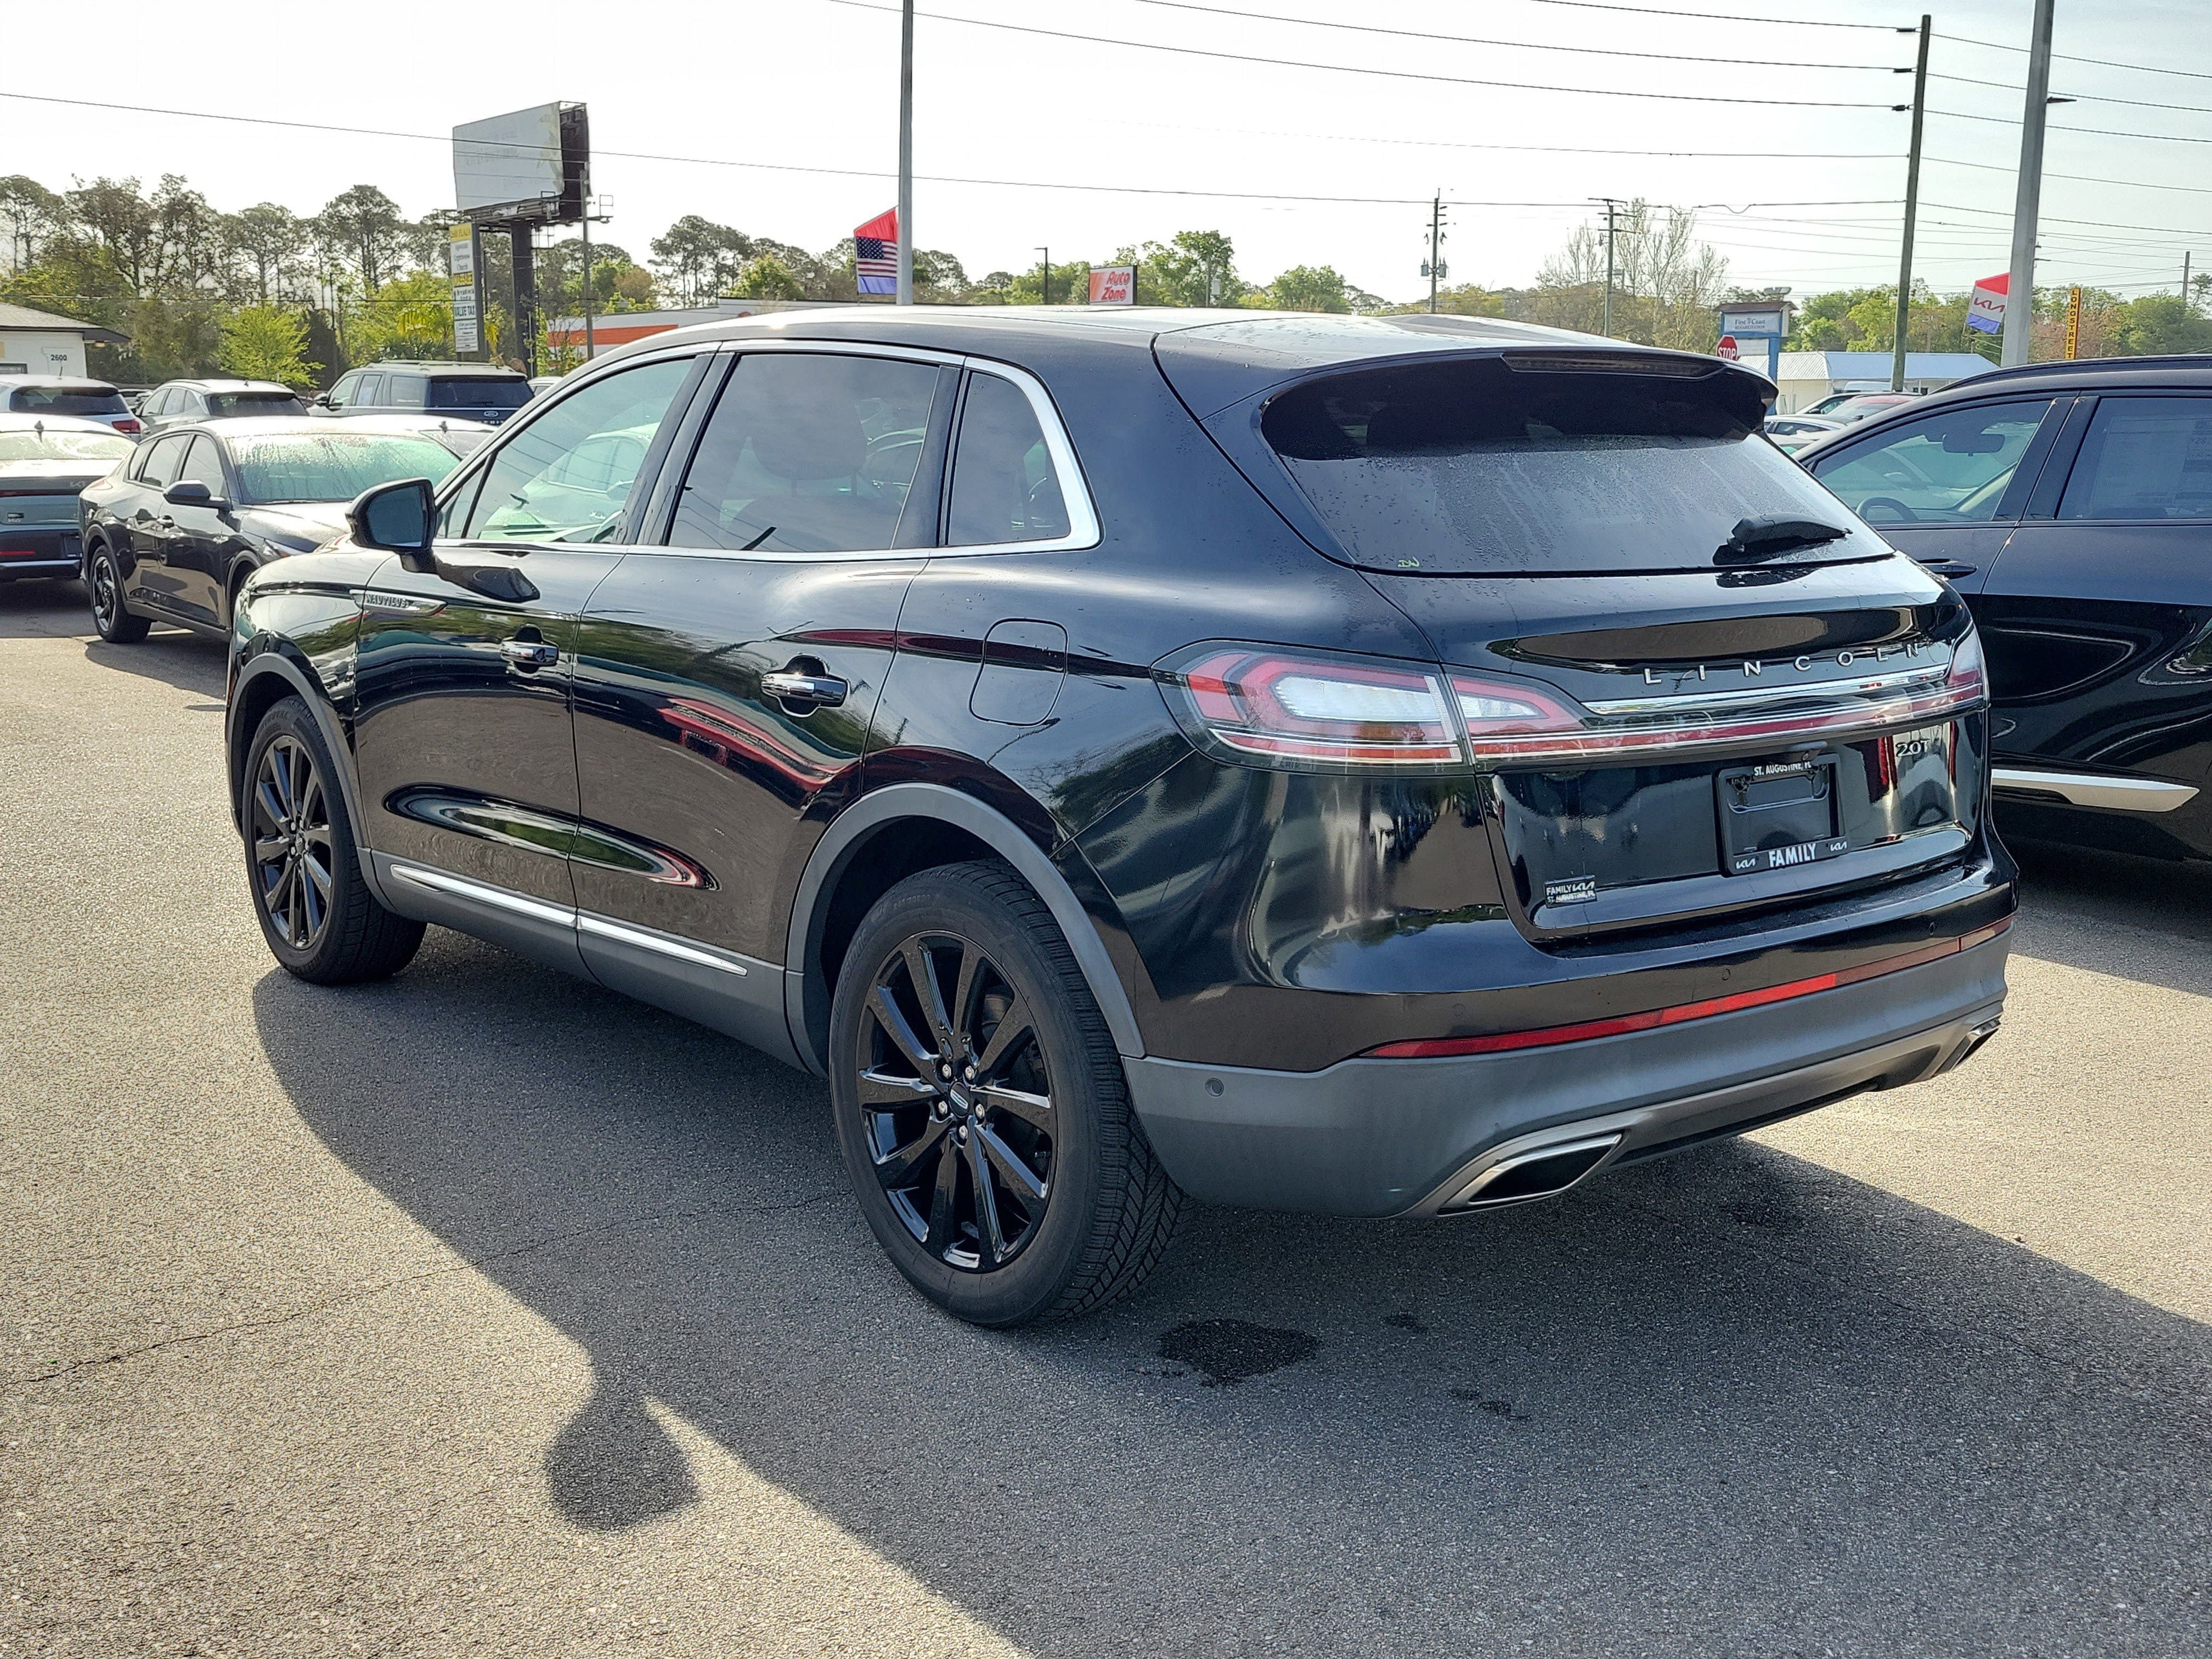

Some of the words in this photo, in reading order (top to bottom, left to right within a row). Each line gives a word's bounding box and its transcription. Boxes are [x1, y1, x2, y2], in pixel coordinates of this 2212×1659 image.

[1106, 271, 1130, 285] Auto
[1101, 287, 1126, 302] Zone
[2067, 290, 2078, 358] LONGSTREET
[1718, 347, 1737, 361] STOP
[1644, 644, 1919, 685] LINCOLN
[1754, 766, 1764, 776] ST.
[1768, 843, 1816, 867] FAMILY
[1547, 884, 1572, 896] FAMILY
